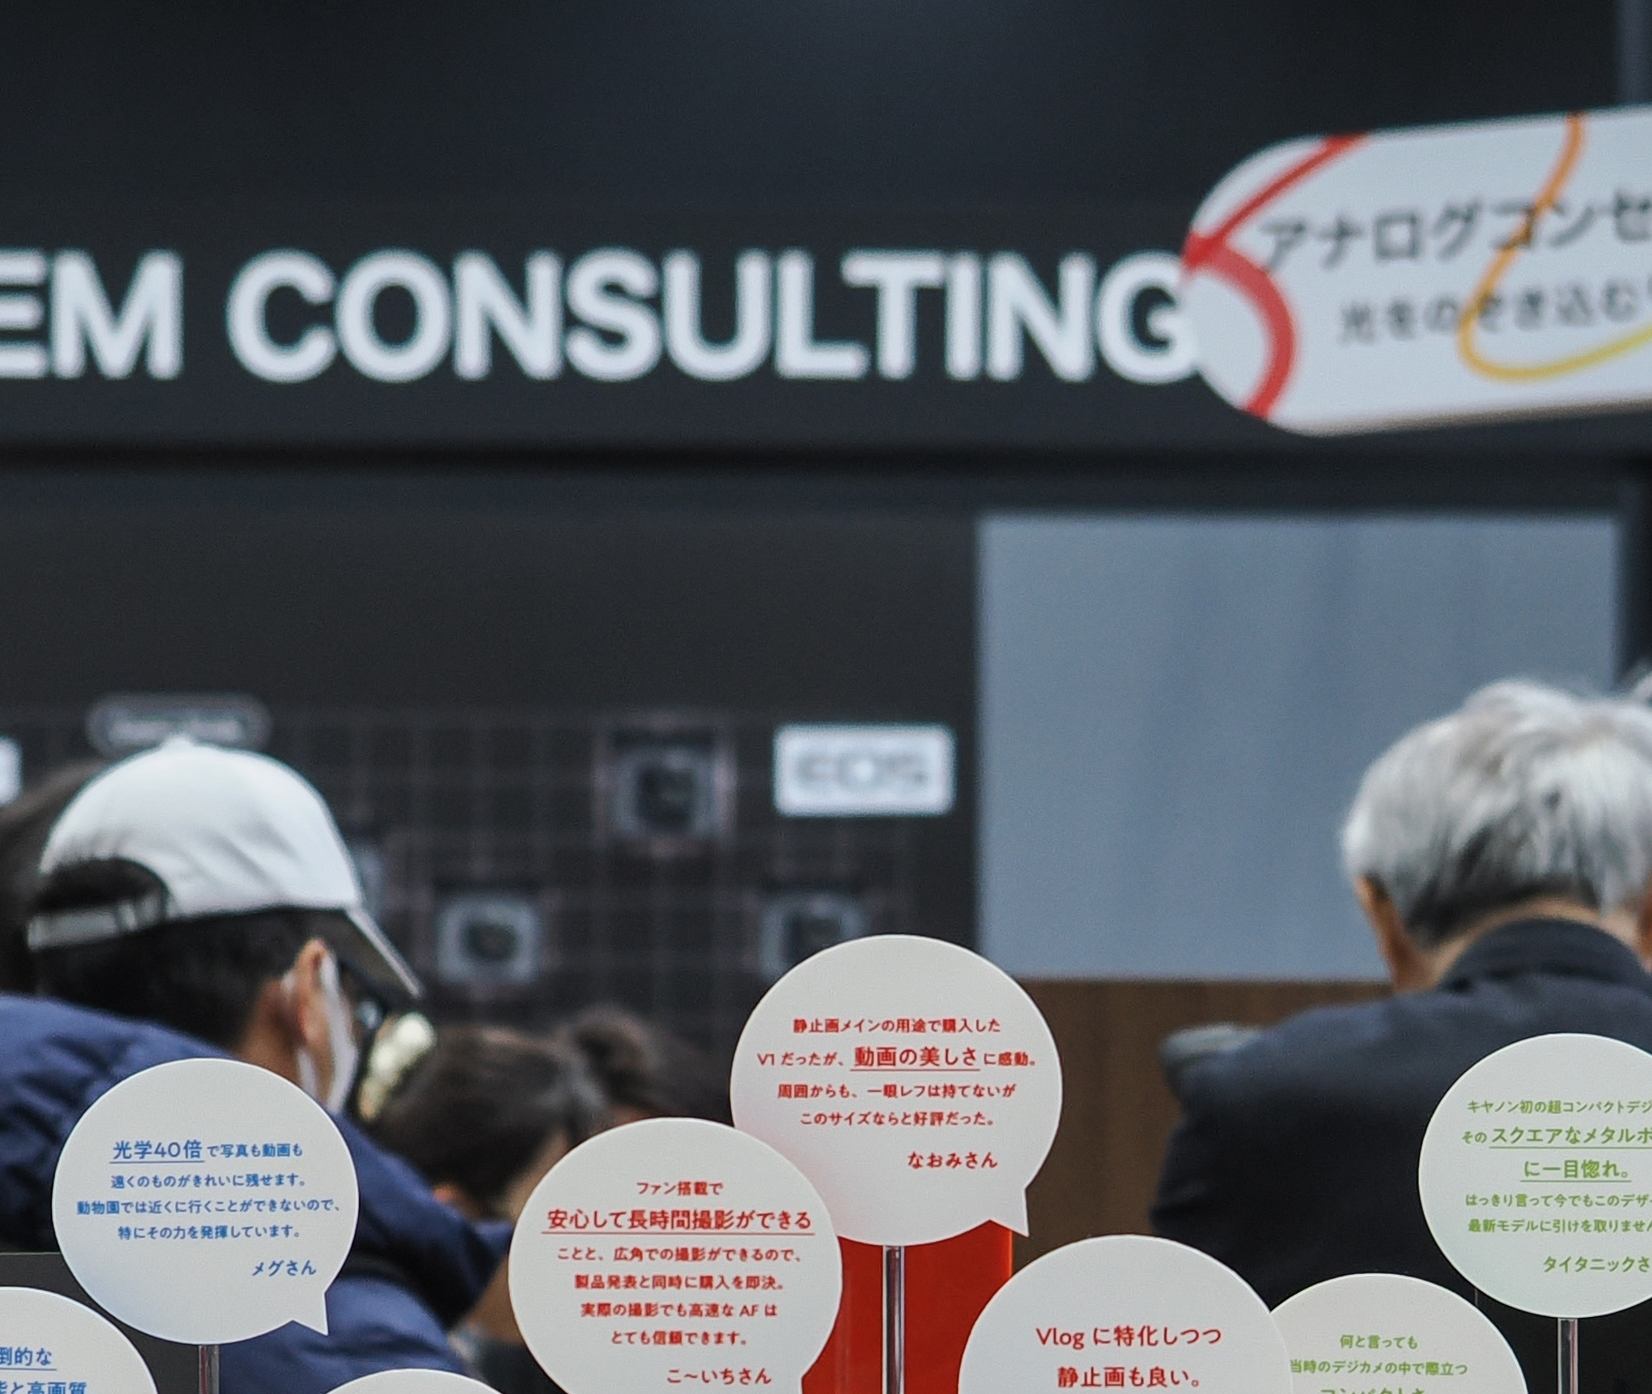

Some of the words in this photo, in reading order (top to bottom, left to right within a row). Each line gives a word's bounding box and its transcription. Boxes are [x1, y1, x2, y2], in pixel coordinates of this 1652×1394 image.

[226, 243, 1199, 383] CONSULTING
[757, 1054, 774, 1065] V1
[781, 1052, 843, 1066] だったが、
[855, 1047, 975, 1067] 動画の美しさ
[984, 1052, 1035, 1066] に感動。
[113, 1140, 202, 1159] 光学40倍
[207, 1144, 302, 1158] で写真も動画も
[909, 1152, 997, 1169] なおみさん
[1525, 1160, 1627, 1178] に一目惚れ。
[637, 1181, 723, 1195] ファン搭載で
[252, 1260, 316, 1276] メグさん
[582, 1303, 733, 1317] 実際の撮影でも高速な
[740, 1305, 758, 1316] AF
[612, 1331, 746, 1345] とても信頼できます。
[1036, 1328, 1084, 1350] Vlog
[1093, 1325, 1221, 1346] に特化しつつ
[1340, 1335, 1417, 1349] 何と言っても
[1058, 1367, 1198, 1387] 静止画も良い。
